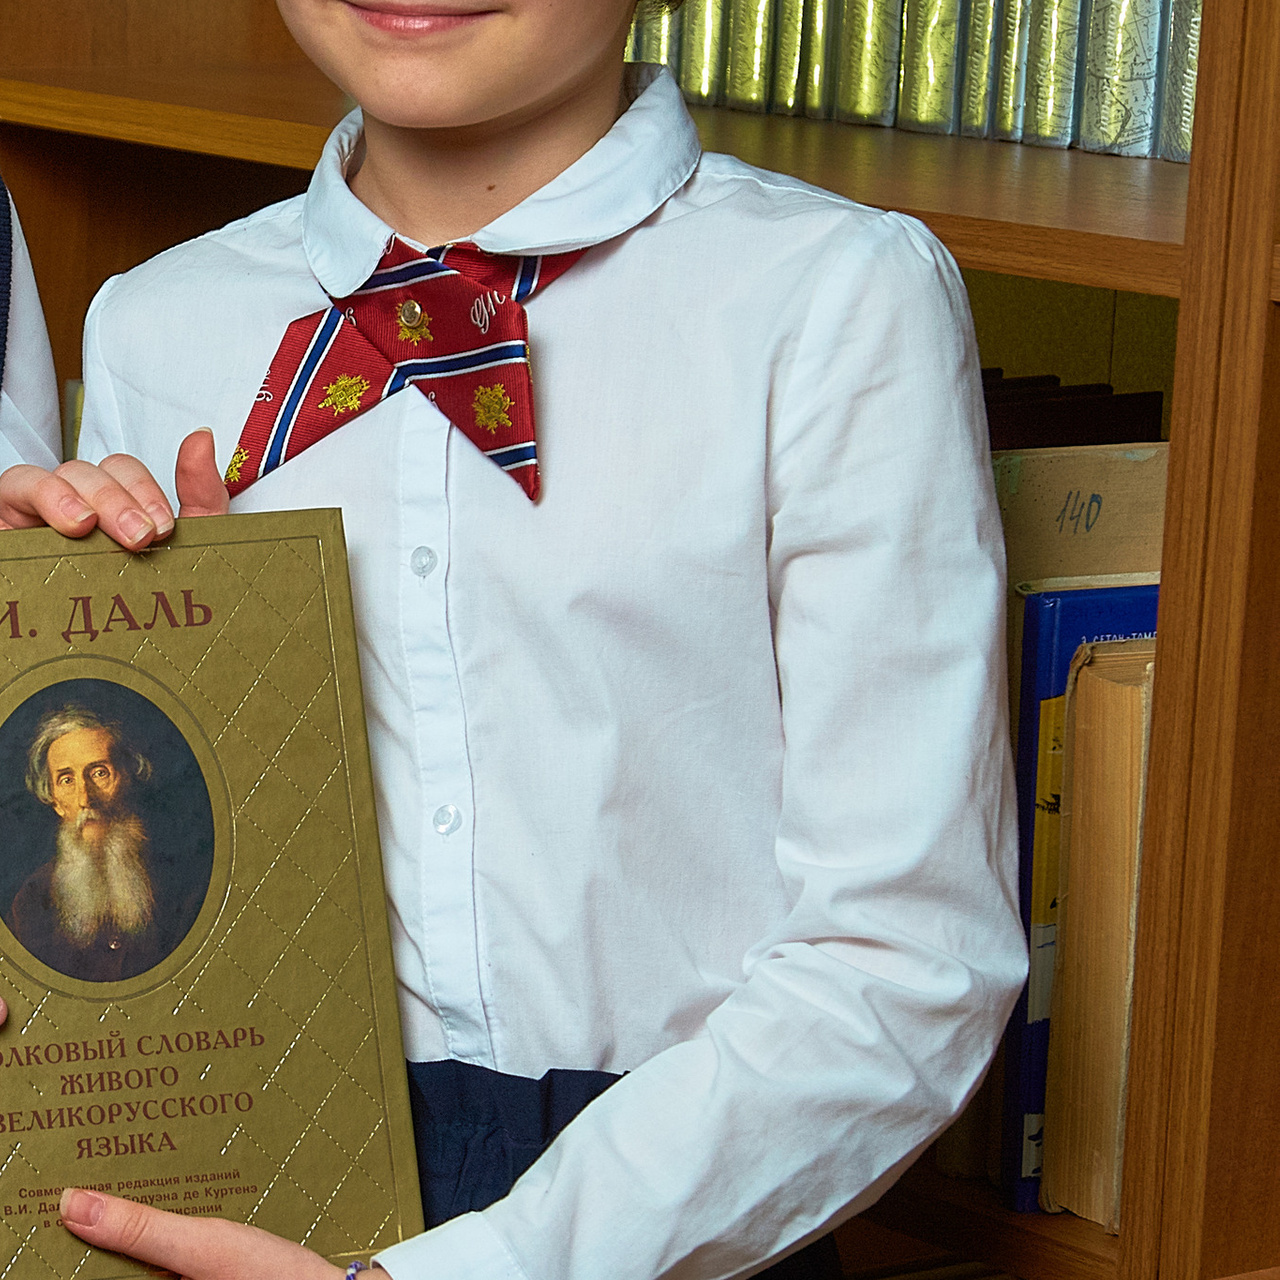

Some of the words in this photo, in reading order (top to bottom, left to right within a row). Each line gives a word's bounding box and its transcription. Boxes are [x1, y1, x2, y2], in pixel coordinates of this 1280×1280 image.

[1055, 489, 1103, 536] 140
[60, 589, 214, 643] ДАЛЬ
[136, 1026, 267, 1058] СЛОВАРЬ
[59, 1064, 180, 1097] ЖИВОГО
[75, 1130, 179, 1161] ЯЗЫКА
[117, 1175, 181, 1192] редакция
[184, 1168, 241, 1184] изданий
[3, 1203, 33, 1216] В.И.
[37, 1201, 61, 1216] Дал
[183, 1189, 201, 1202] де
[204, 1184, 259, 1199] Куртенэ
[43, 1219, 52, 1228] в
